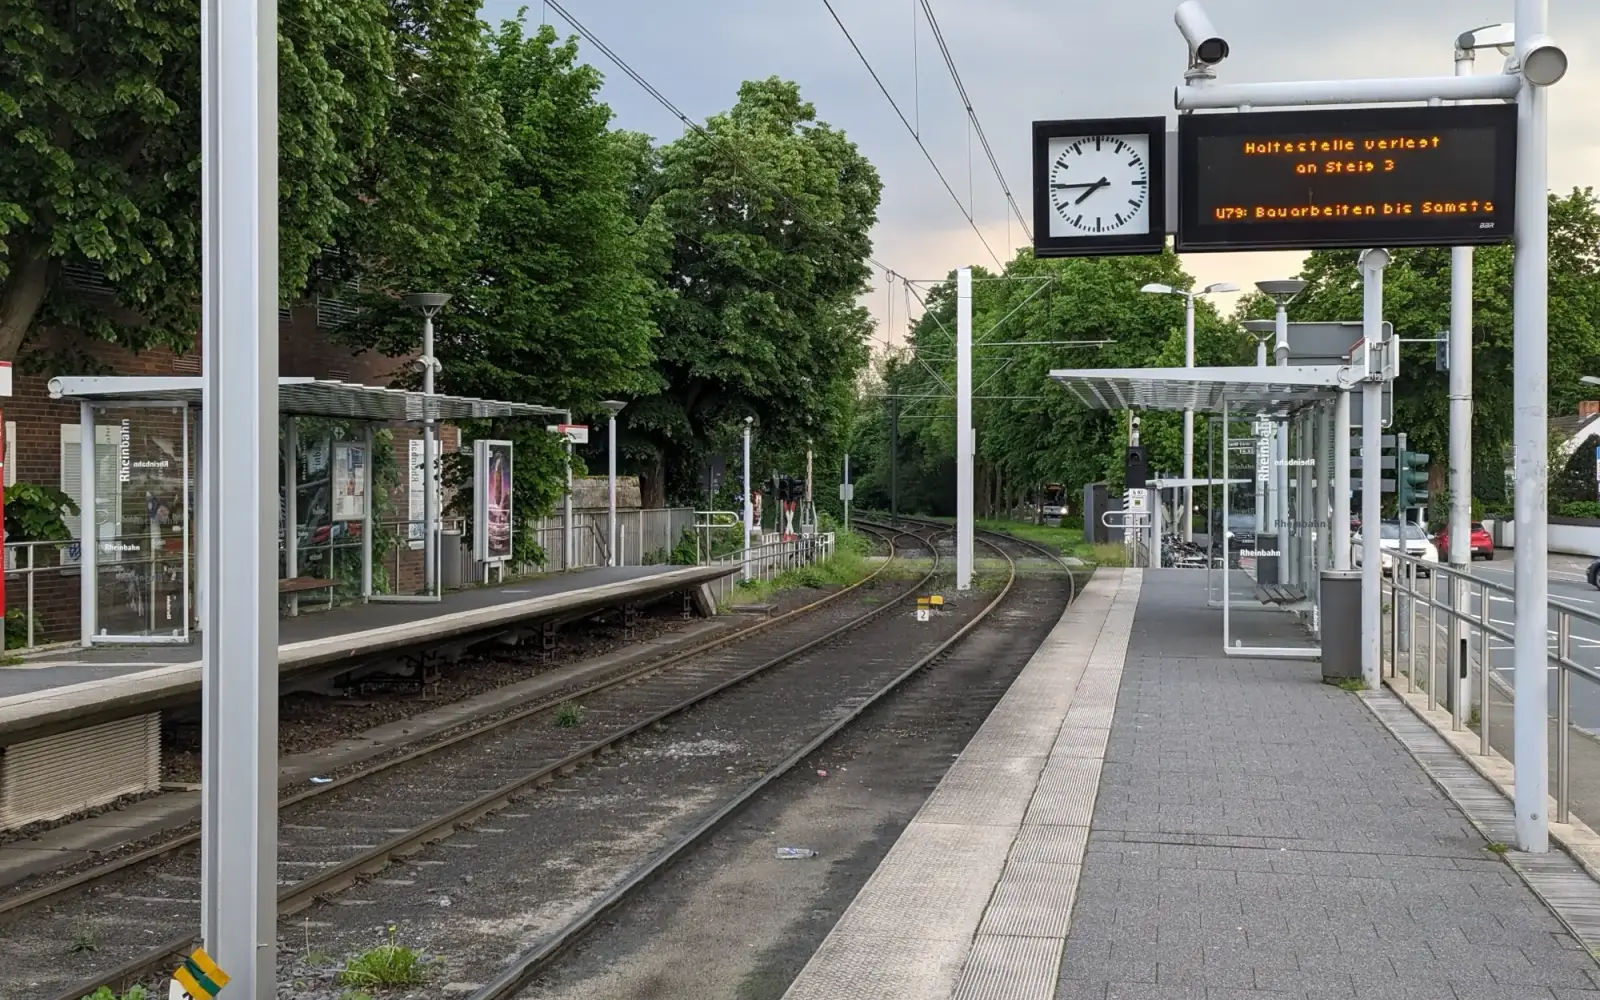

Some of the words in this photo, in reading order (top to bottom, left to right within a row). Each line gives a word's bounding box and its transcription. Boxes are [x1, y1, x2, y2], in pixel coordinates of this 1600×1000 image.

[1245, 140, 1354, 153] Haltestelle
[1365, 137, 1439, 149] verlegt
[1296, 163, 1317, 173] an
[1325, 161, 1374, 173] Steig
[1384, 160, 1394, 171] 3
[1216, 207, 1247, 219] U79:
[1256, 204, 1376, 218] Bauarbeiten
[1383, 203, 1412, 214] bis
[120, 418, 130, 482] Rheinbahn
[1258, 413, 1271, 482] Rheinbahn
[104, 543, 141, 551] Rheinbahn
[1240, 549, 1281, 557] Rheinbahn
[920, 610, 926, 619] 2
